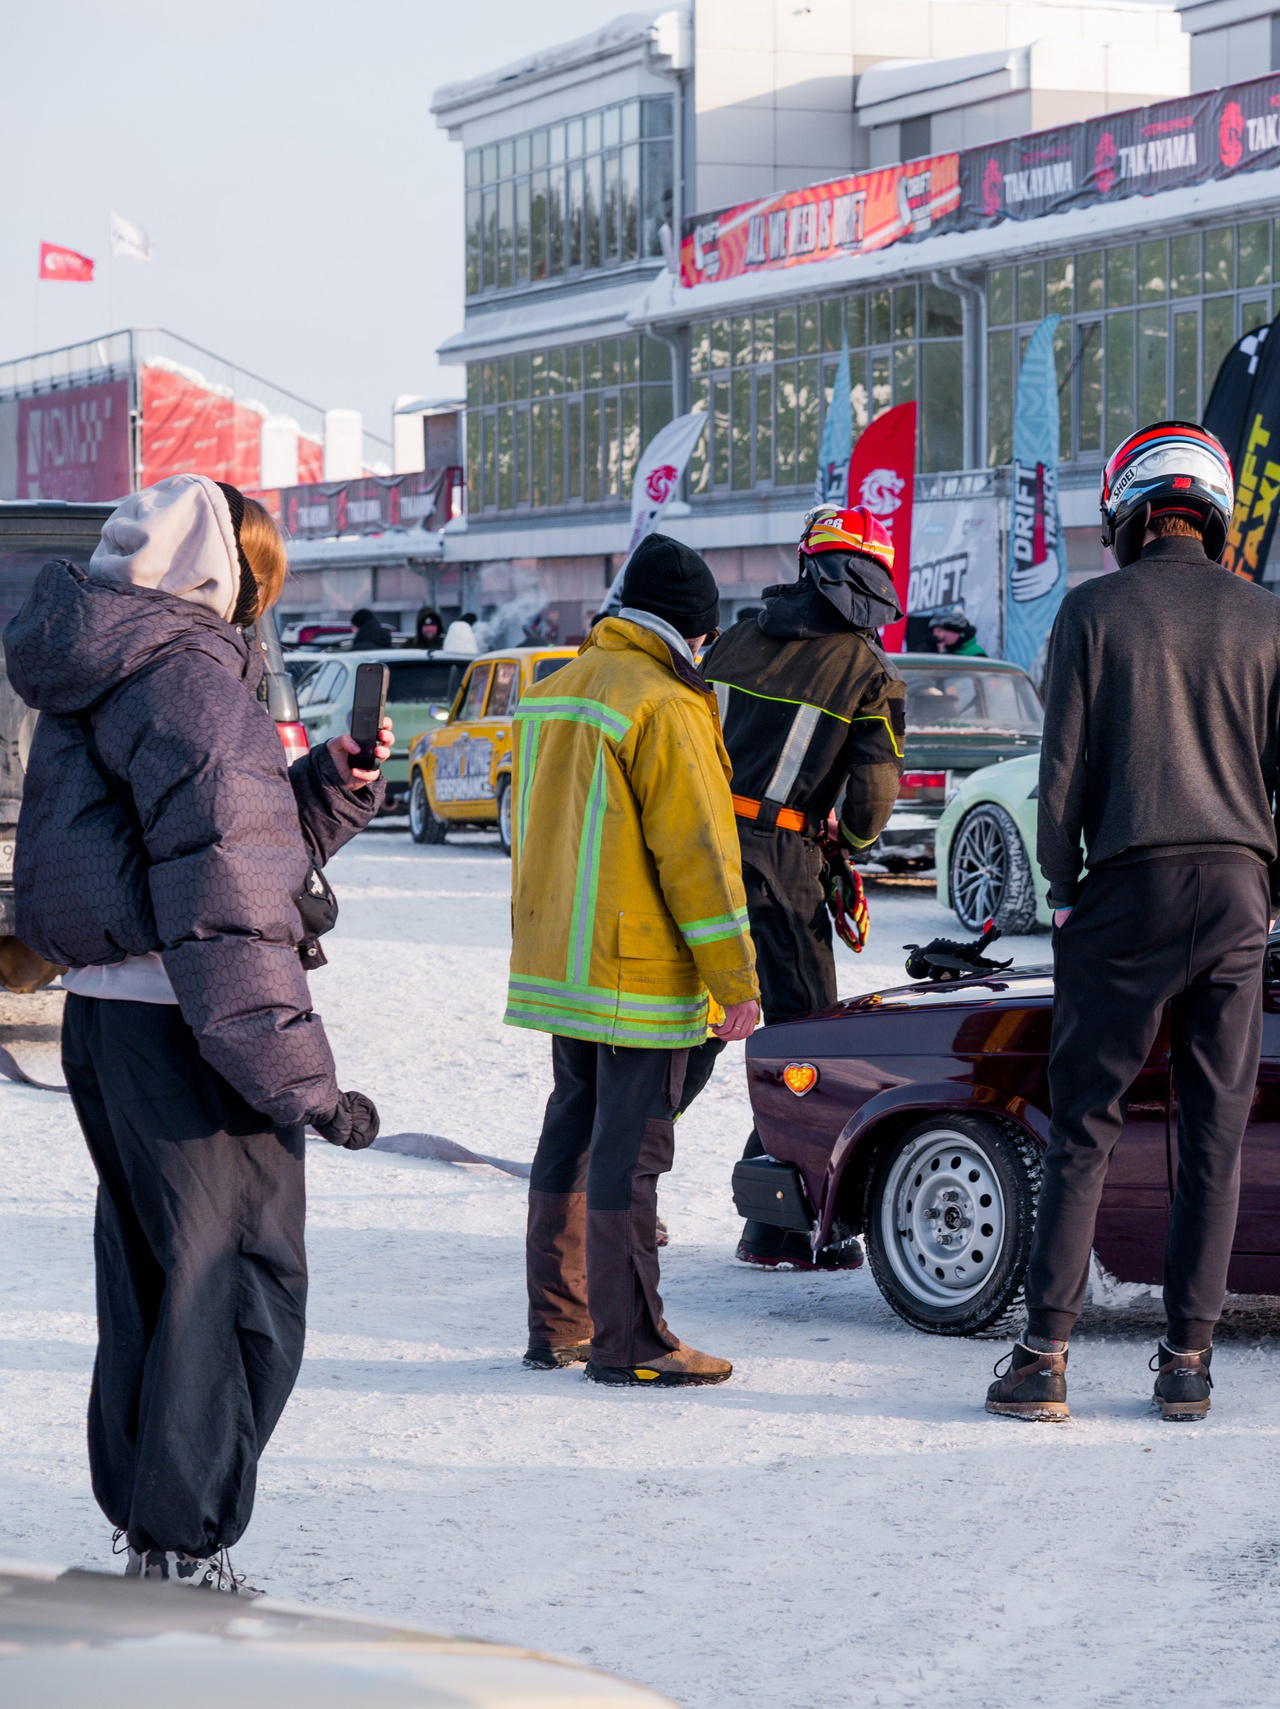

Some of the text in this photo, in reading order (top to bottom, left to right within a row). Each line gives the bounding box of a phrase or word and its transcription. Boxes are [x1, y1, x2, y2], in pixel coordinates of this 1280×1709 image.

[1117, 132, 1197, 179] TAKAYAMA
[1003, 160, 1074, 204] TAKAYAMA
[745, 214, 767, 266] ALL
[788, 201, 818, 257] NEED
[818, 198, 832, 252] IS
[1113, 468, 1136, 500] SHOEI
[1013, 459, 1037, 563] DRIFT
[908, 557, 967, 612] DRIFT
